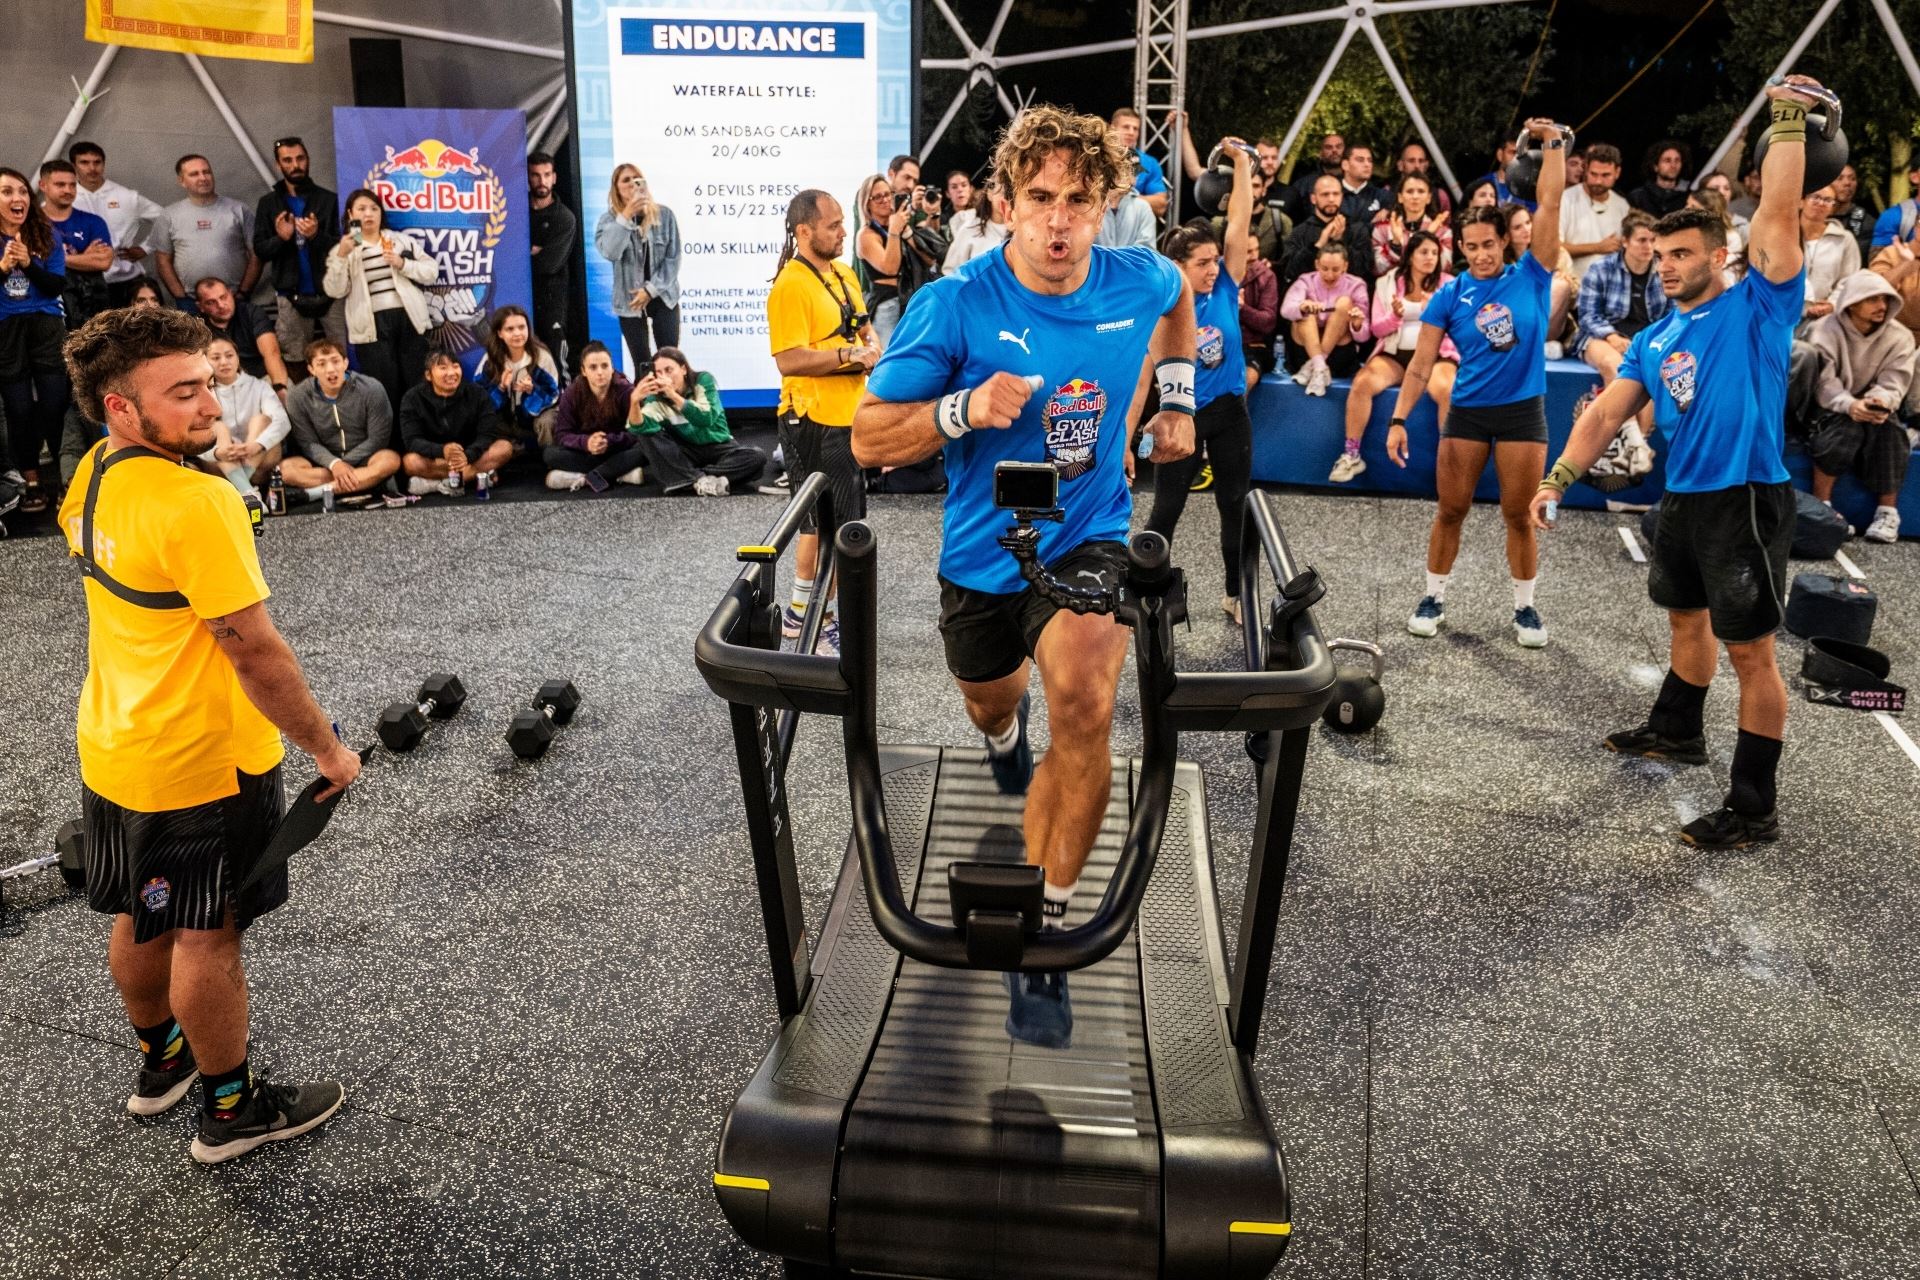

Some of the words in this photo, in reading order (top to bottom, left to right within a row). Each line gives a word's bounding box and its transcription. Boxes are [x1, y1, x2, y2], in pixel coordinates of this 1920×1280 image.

[653, 24, 836, 52] ENDURANCE
[673, 84, 763, 97] WATERFALL
[768, 86, 816, 98] STYLE:
[664, 125, 696, 137] 60M
[702, 125, 775, 138] SANDBAG
[781, 126, 827, 138] CARRY
[712, 144, 781, 159] 20/40KG
[376, 182, 433, 210] Red
[437, 182, 492, 211] Bull
[694, 184, 702, 197] 6
[708, 184, 754, 197] DEVILS
[760, 184, 800, 197] PRESS
[695, 204, 702, 216] 2
[708, 204, 716, 216] X
[684, 242, 715, 255] 00M
[721, 242, 785, 255] SKILLMIL
[435, 250, 494, 285] ASH
[681, 288, 702, 298] ACH
[705, 288, 744, 298] ATHLETE
[681, 301, 731, 311] RUNNING
[734, 301, 767, 310] ATHLET
[691, 314, 743, 323] KETTLEBELL
[746, 313, 769, 323] OVE
[692, 327, 719, 336] UNTIL
[722, 327, 743, 336] RUN
[746, 326, 754, 336] IS
[1050, 399, 1077, 416] Red
[1078, 395, 1104, 411] Bull
[1055, 418, 1094, 432] GYM
[1046, 426, 1099, 446] CLASH
